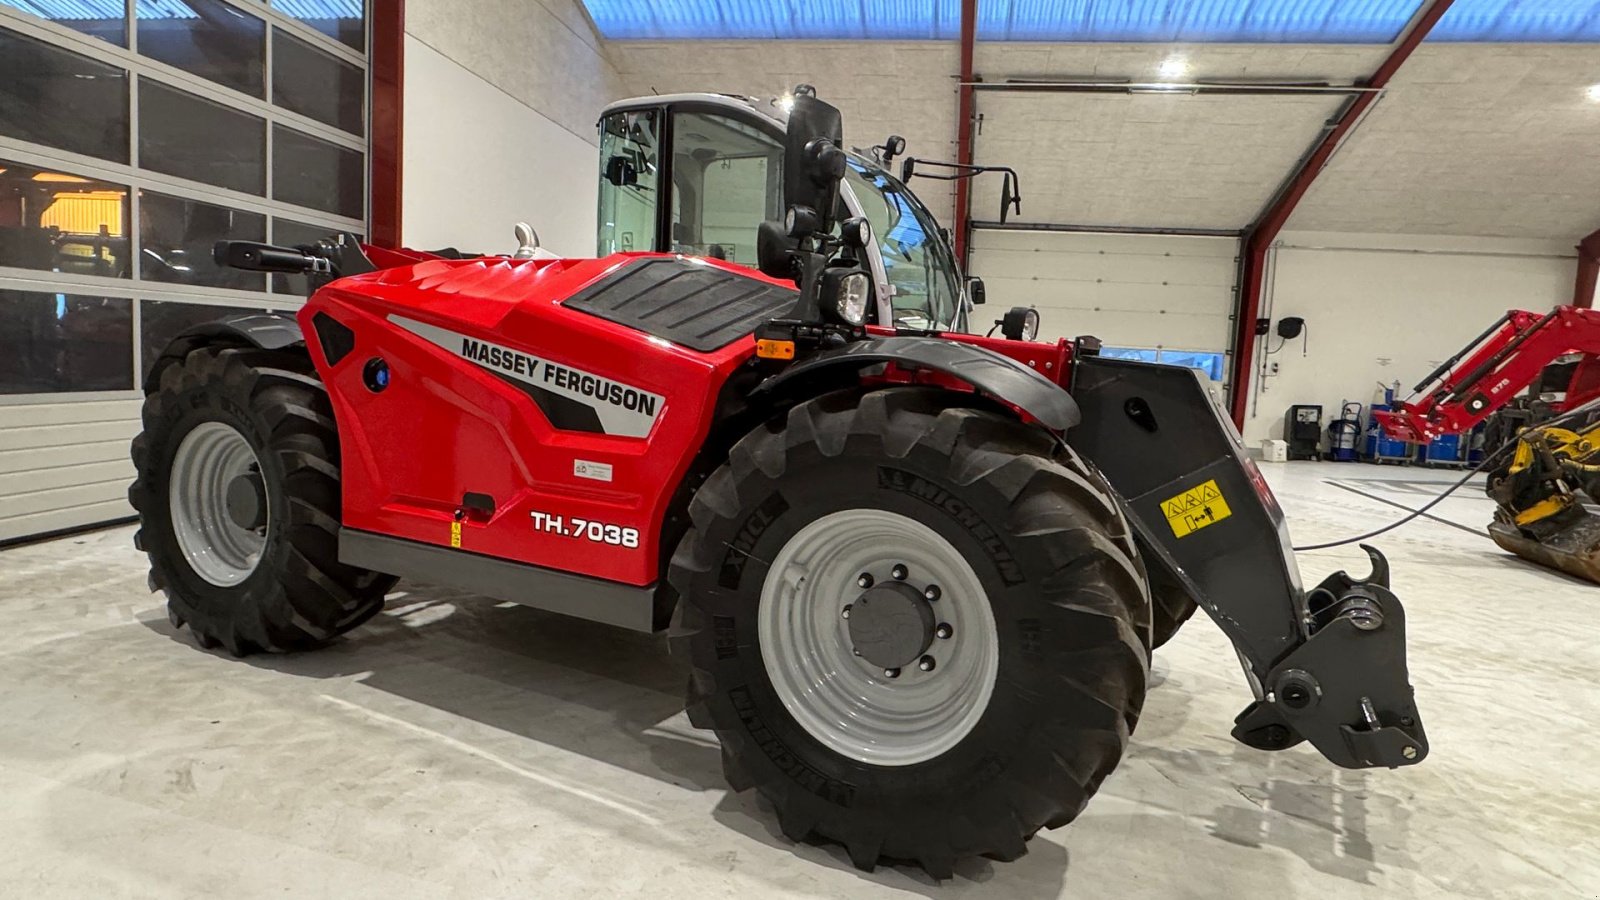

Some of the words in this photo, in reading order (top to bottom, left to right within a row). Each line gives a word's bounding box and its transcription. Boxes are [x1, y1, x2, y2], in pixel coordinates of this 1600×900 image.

[462, 338, 539, 377] MASSEY
[544, 364, 656, 416] FERGUSON
[530, 511, 640, 549] TH.7038
[910, 478, 1024, 583] MICHELIN
